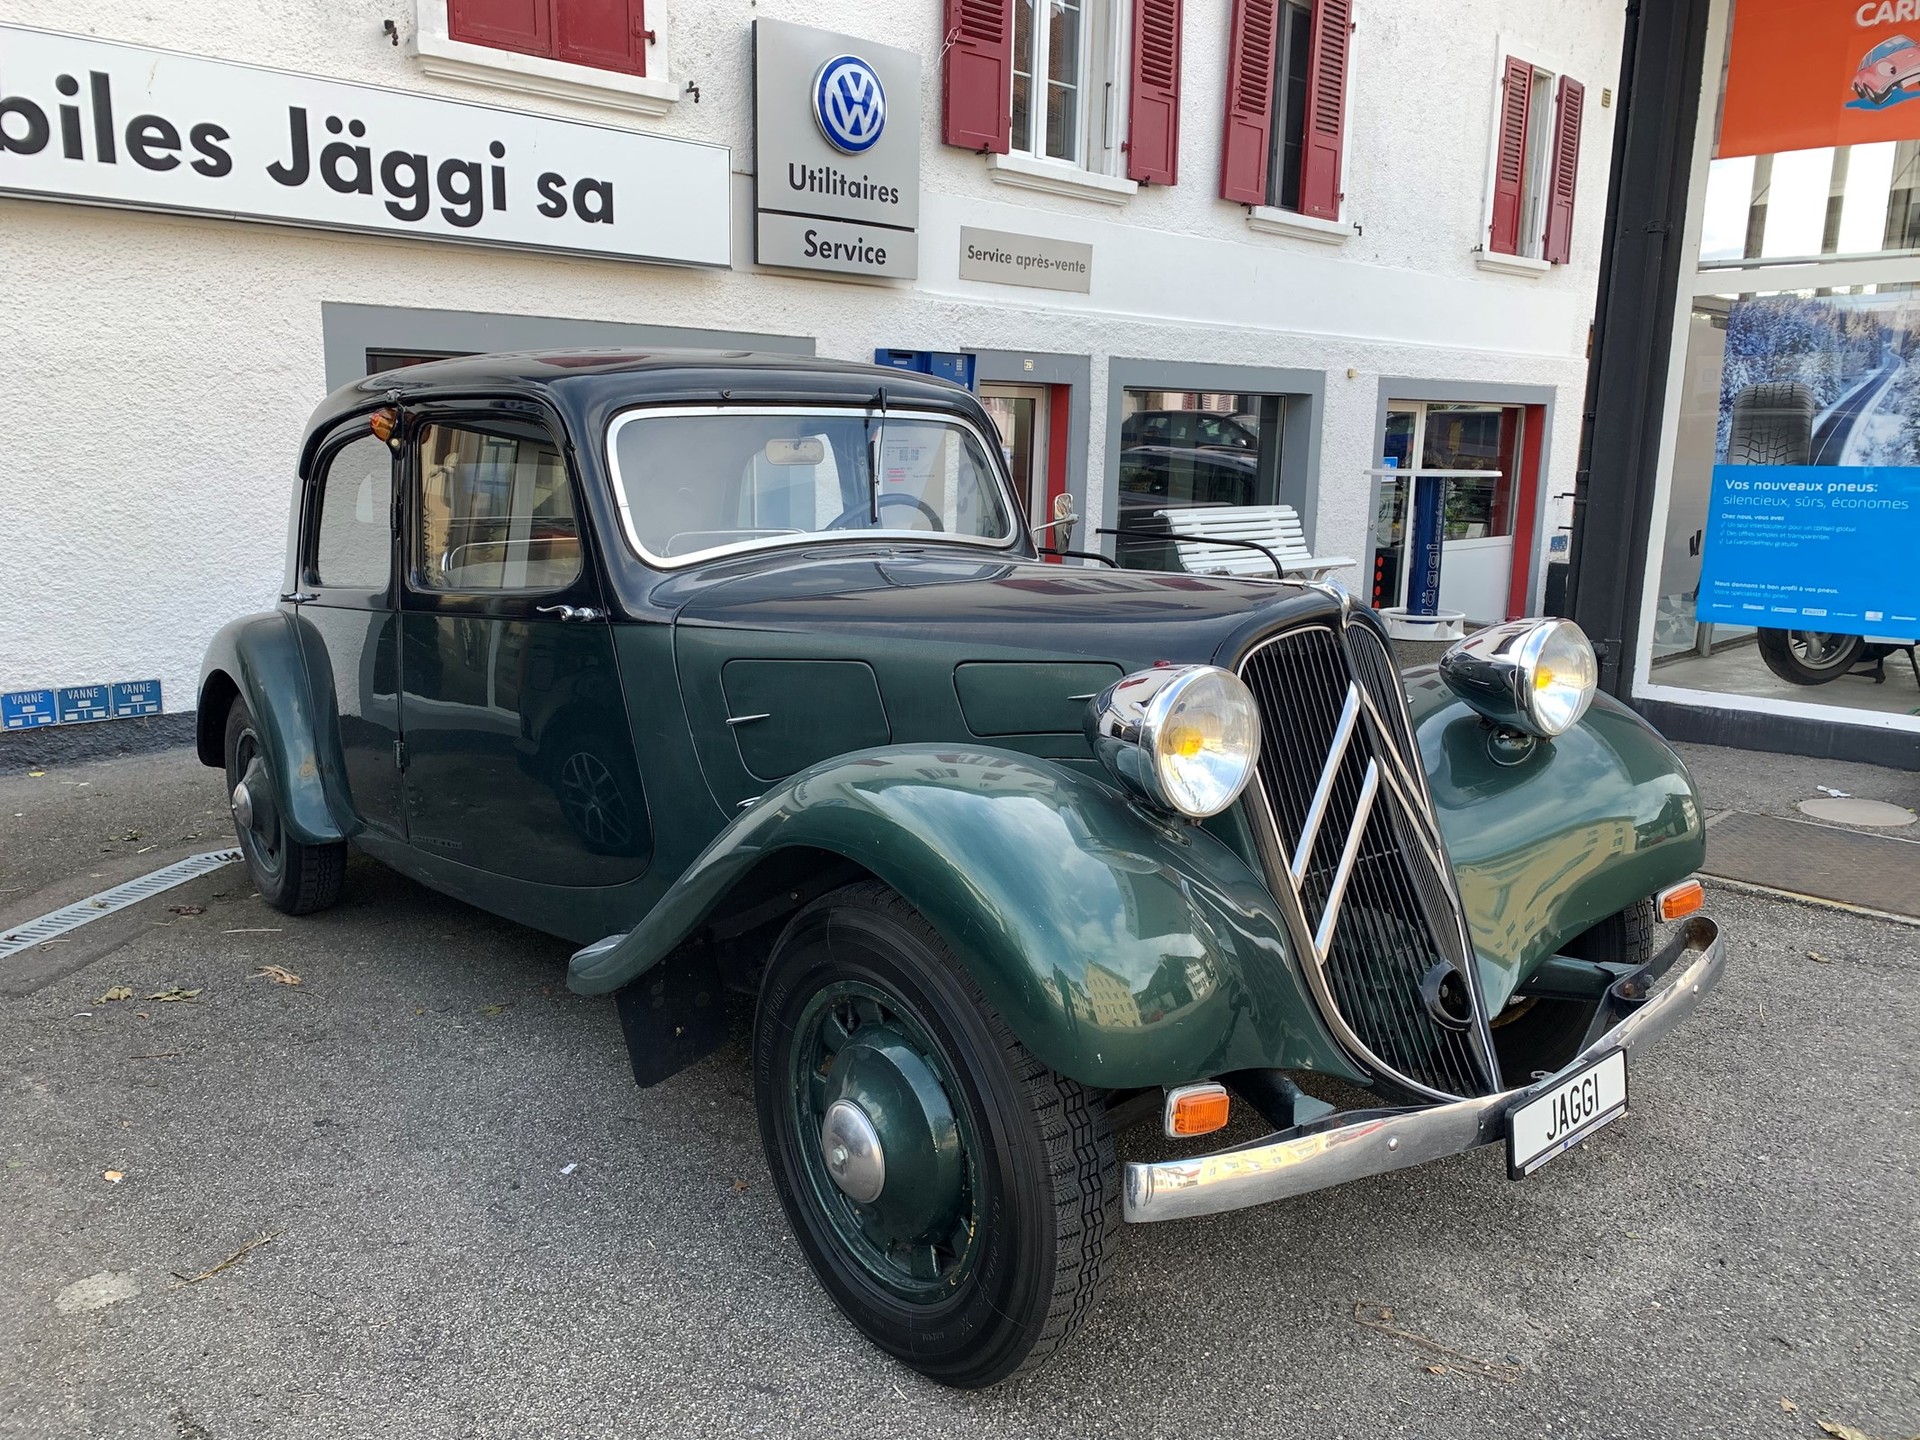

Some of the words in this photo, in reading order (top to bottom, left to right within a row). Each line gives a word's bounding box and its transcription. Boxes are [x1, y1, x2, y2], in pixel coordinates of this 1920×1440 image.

[265, 105, 507, 228] Jäggi
[536, 171, 614, 225] sa
[788, 161, 900, 206] Utilitaires
[803, 228, 887, 266] Service
[967, 243, 1012, 266] Service
[1015, 253, 1087, 275] après-vente
[1725, 479, 1750, 490] Vos
[1753, 481, 1823, 492] nouveaux
[1827, 482, 1879, 494] pneus:
[1723, 494, 1791, 508] silencieux,
[1795, 495, 1827, 509] sûrs,
[1831, 496, 1910, 510] économes
[11, 692, 44, 705] VANNE
[67, 688, 99, 700] VANNE
[121, 682, 151, 695] VANNE
[1546, 1072, 1600, 1141] JAGGI
